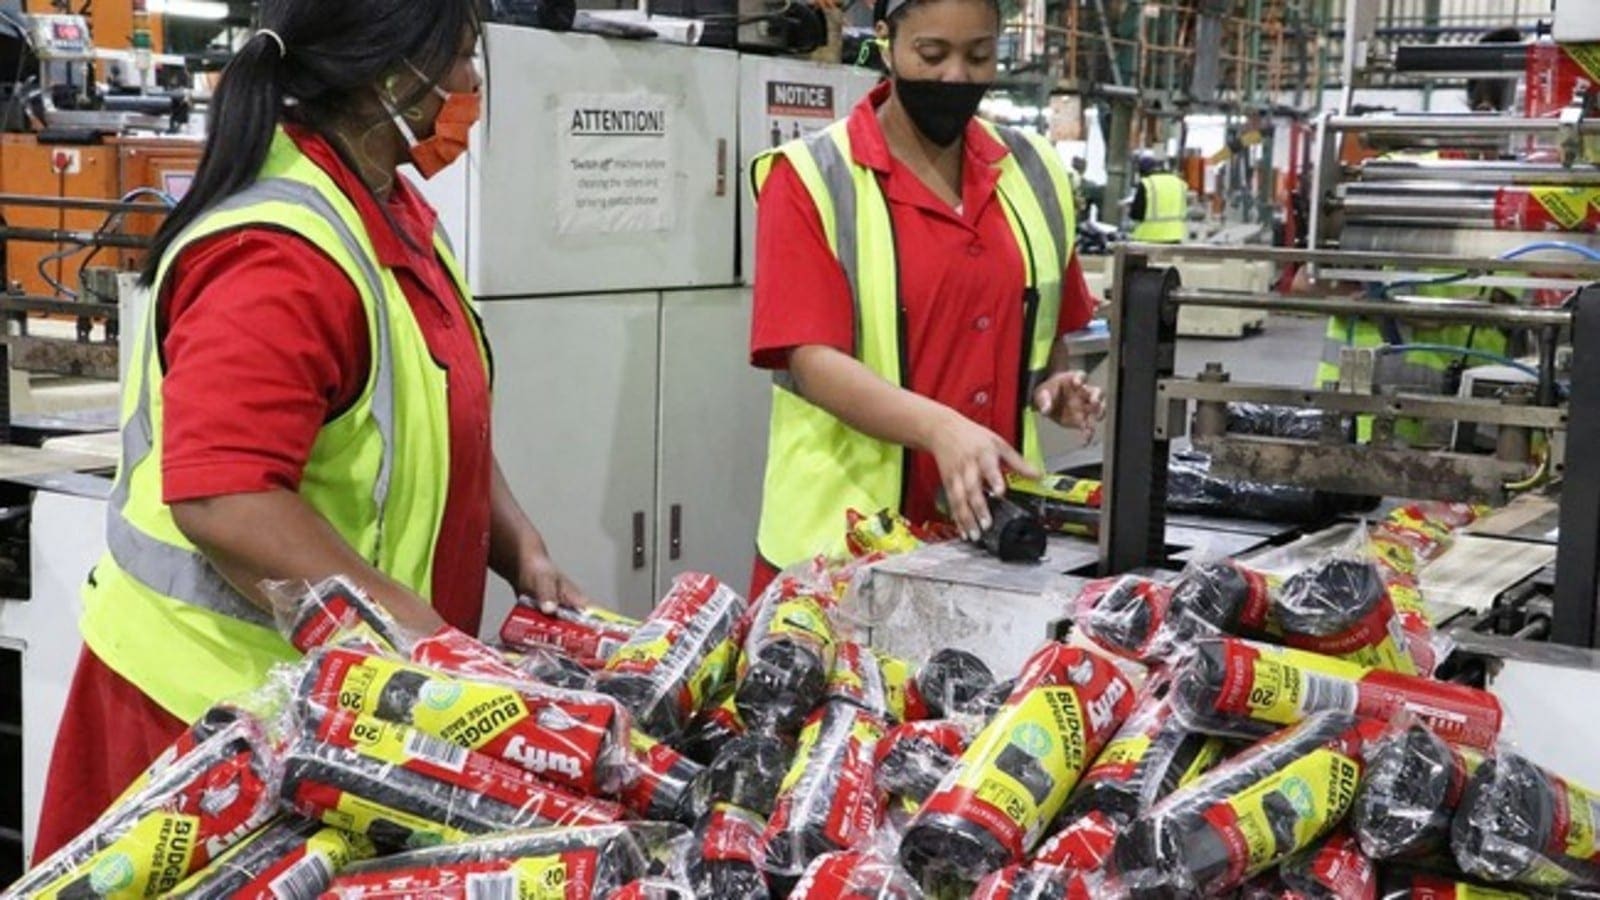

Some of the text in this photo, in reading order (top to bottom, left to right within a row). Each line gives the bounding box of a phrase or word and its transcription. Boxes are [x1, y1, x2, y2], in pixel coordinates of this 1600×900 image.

[775, 84, 826, 107] NOTICE
[571, 109, 665, 131] ATTENTION!
[340, 691, 362, 709] 20
[1252, 687, 1273, 705] 20
[354, 723, 379, 741] 20
[454, 702, 520, 748] BUDGE
[1056, 691, 1084, 771] BUDGET
[503, 735, 583, 780] tuffy
[1005, 797, 1026, 821] 20
